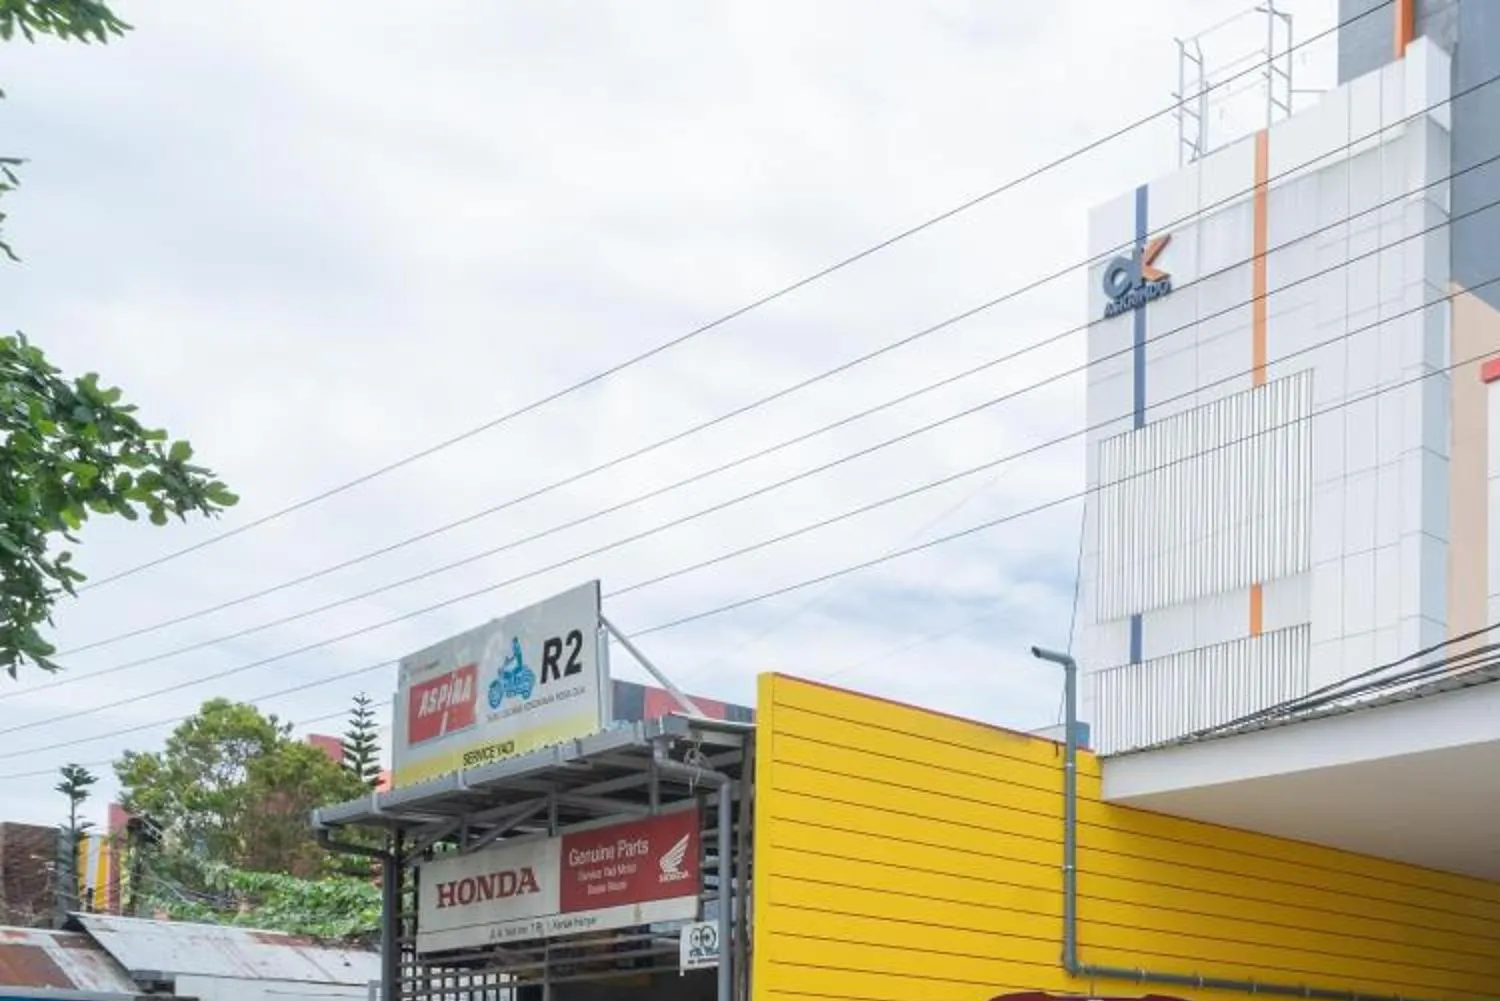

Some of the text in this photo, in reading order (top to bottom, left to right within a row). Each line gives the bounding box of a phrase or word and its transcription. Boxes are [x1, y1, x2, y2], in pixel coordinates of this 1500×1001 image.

[539, 629, 584, 685] R2
[617, 838, 649, 859] Parts
[435, 866, 541, 909] HONDA
